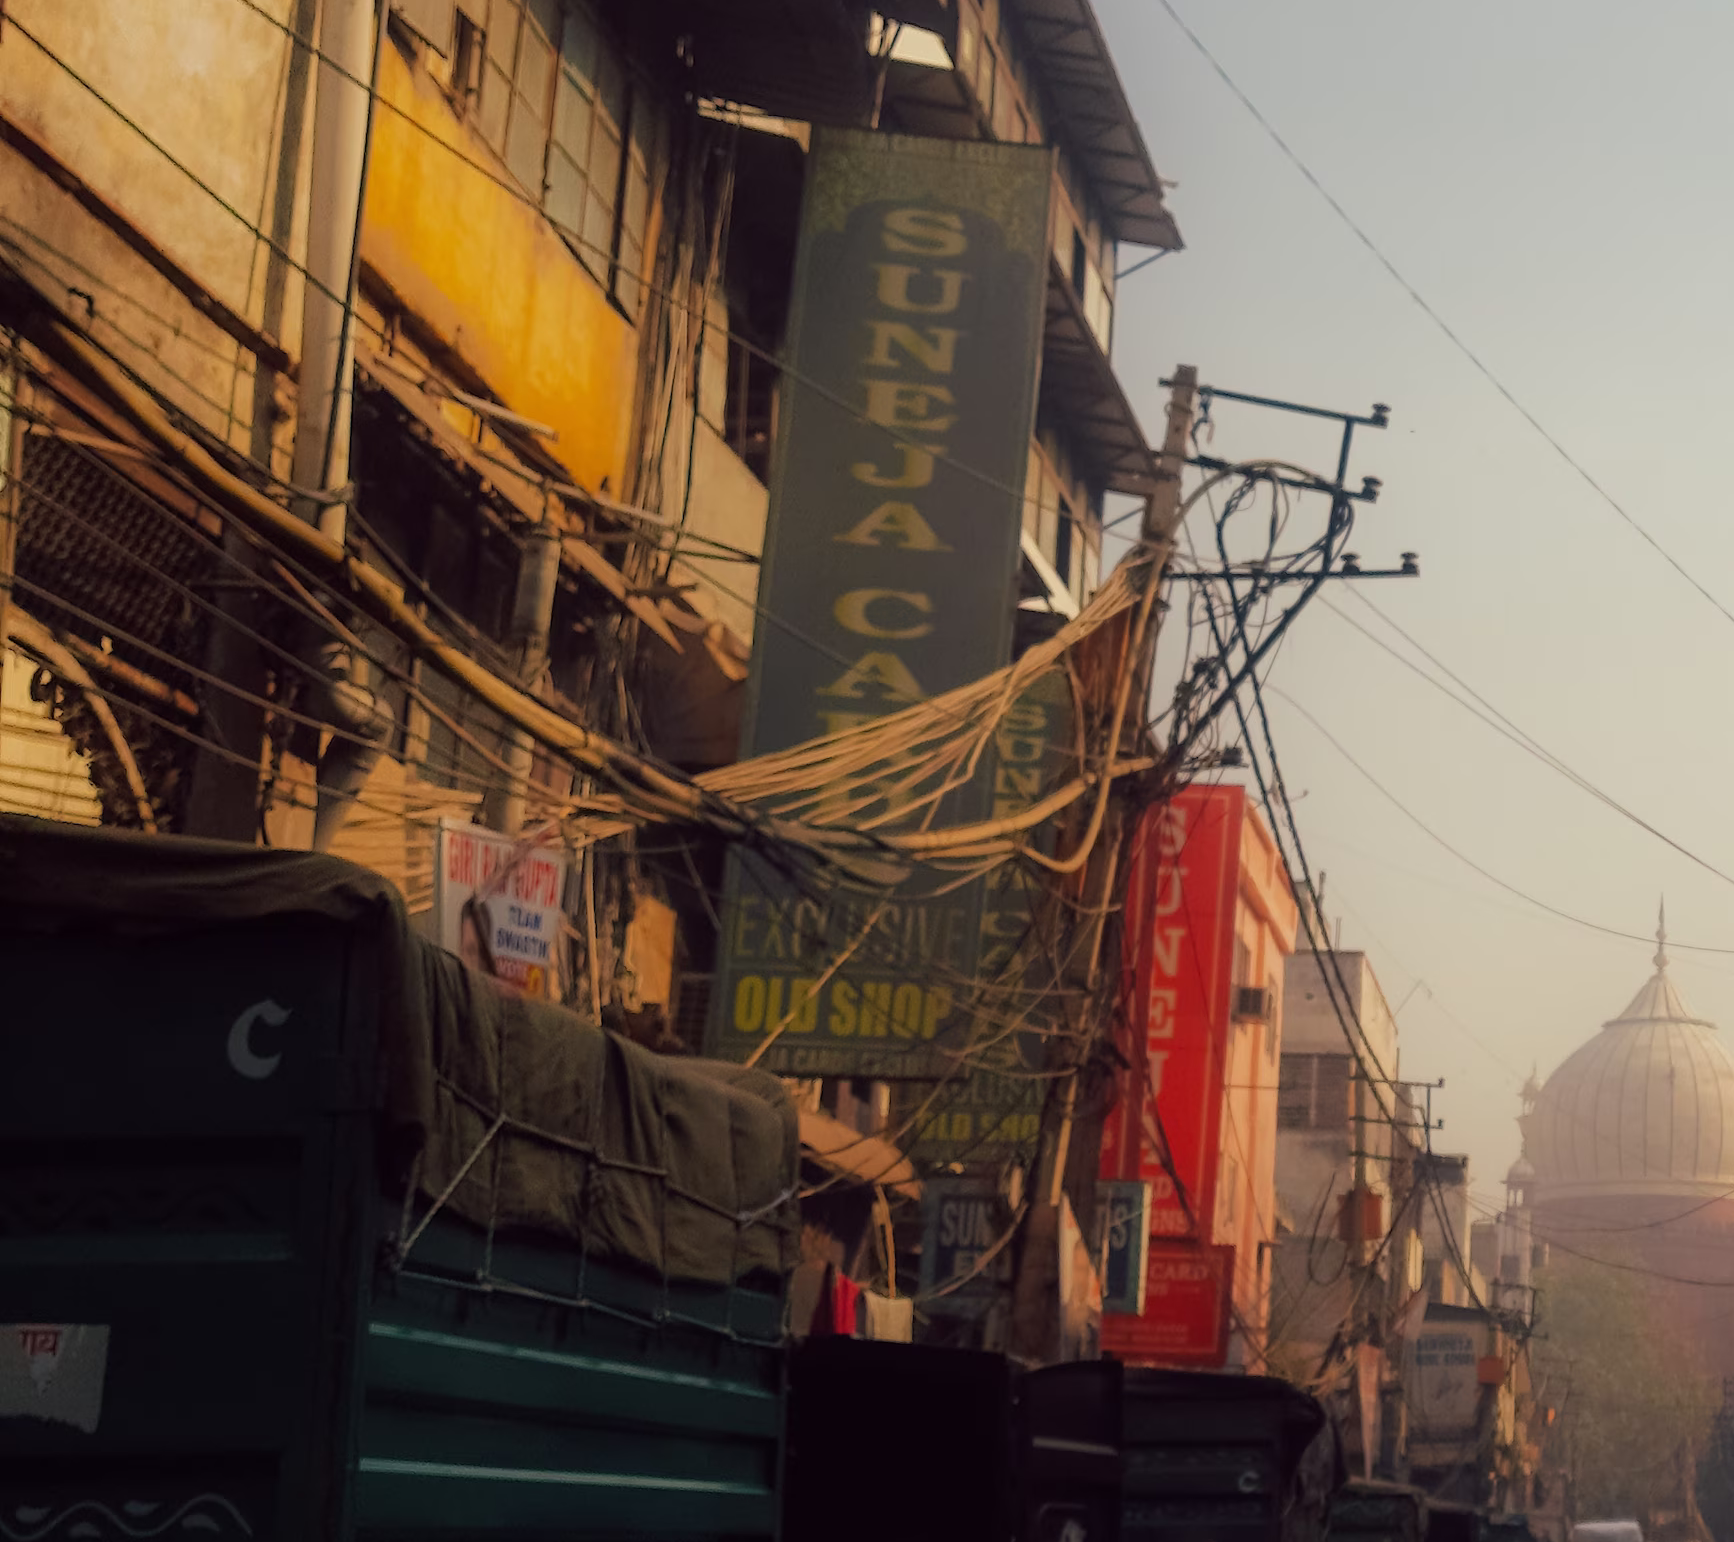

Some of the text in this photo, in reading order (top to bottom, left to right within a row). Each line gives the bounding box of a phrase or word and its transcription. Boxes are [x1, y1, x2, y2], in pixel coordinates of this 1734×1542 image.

[831, 207, 972, 553] SUNEJA
[735, 894, 967, 965] EXCSIVE
[226, 998, 292, 1080] C
[733, 974, 954, 1041] OLD SHOP
